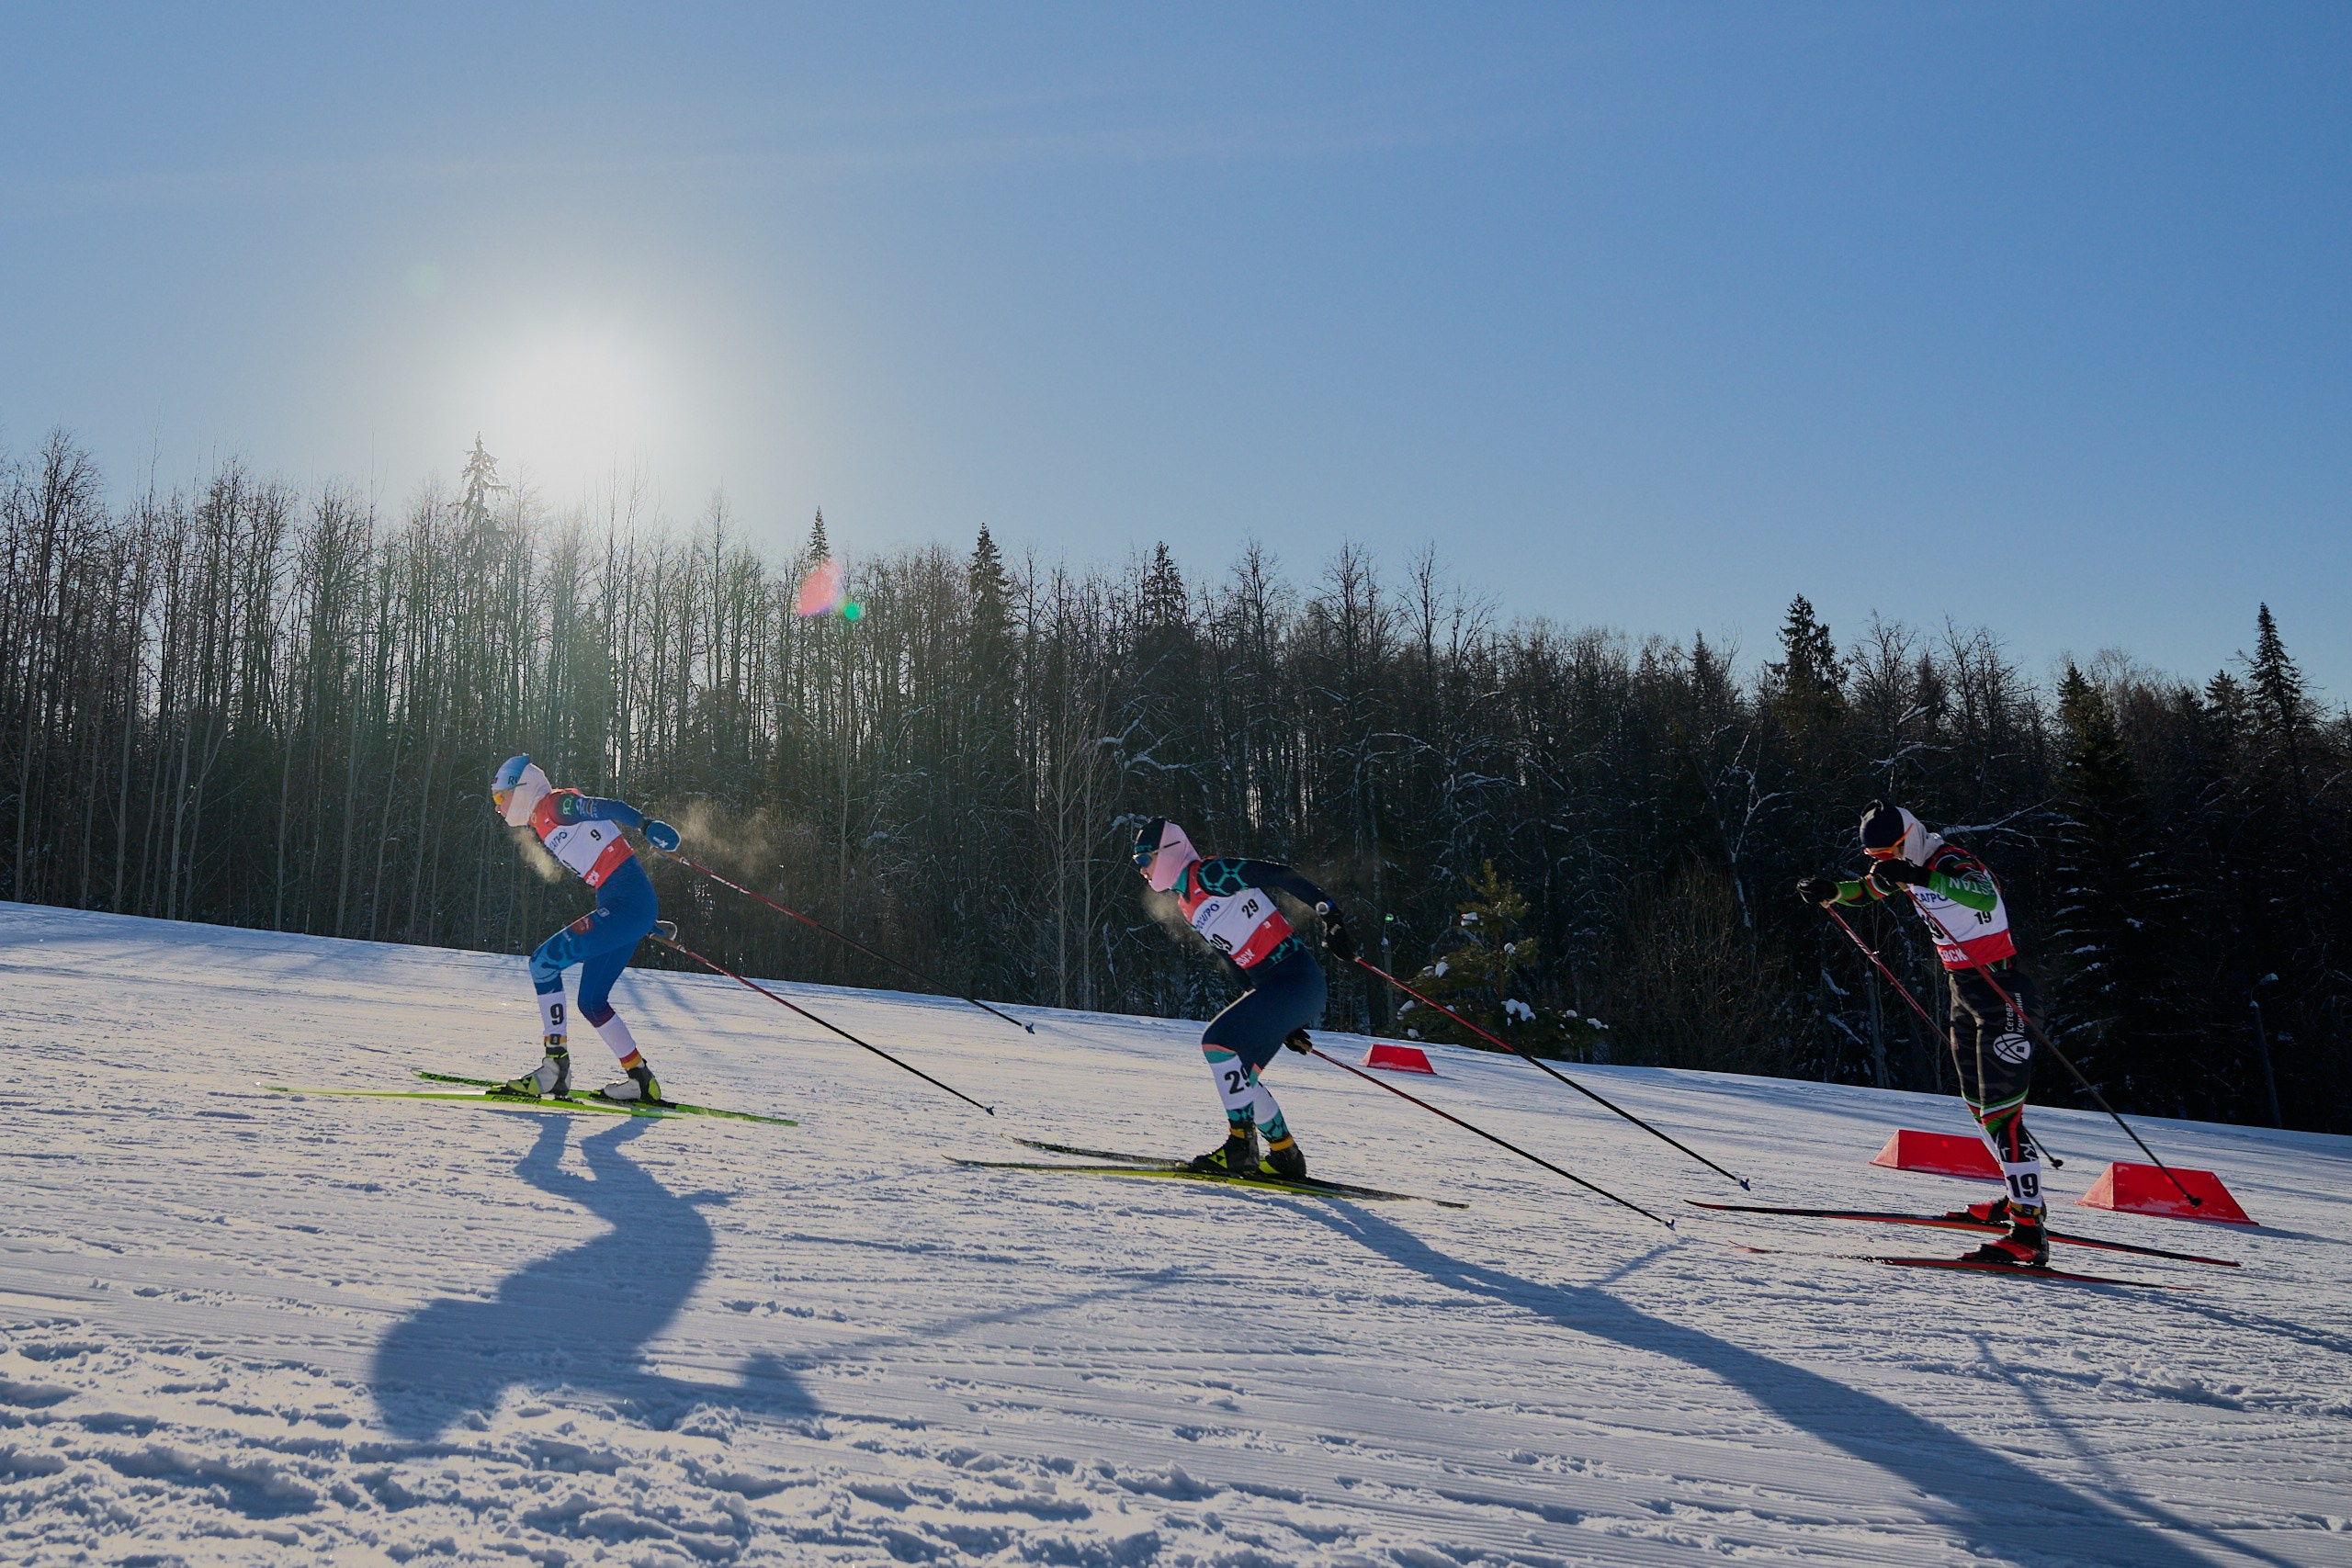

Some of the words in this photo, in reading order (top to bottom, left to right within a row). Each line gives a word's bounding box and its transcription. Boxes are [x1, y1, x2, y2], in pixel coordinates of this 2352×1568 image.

[590, 829, 602, 841] 9
[1241, 898, 1260, 919] 29
[1973, 910, 1992, 925] 19
[549, 1003, 564, 1026] 9
[492, 1094, 542, 1105] FISCHER
[2007, 1173, 2039, 1198] 19
